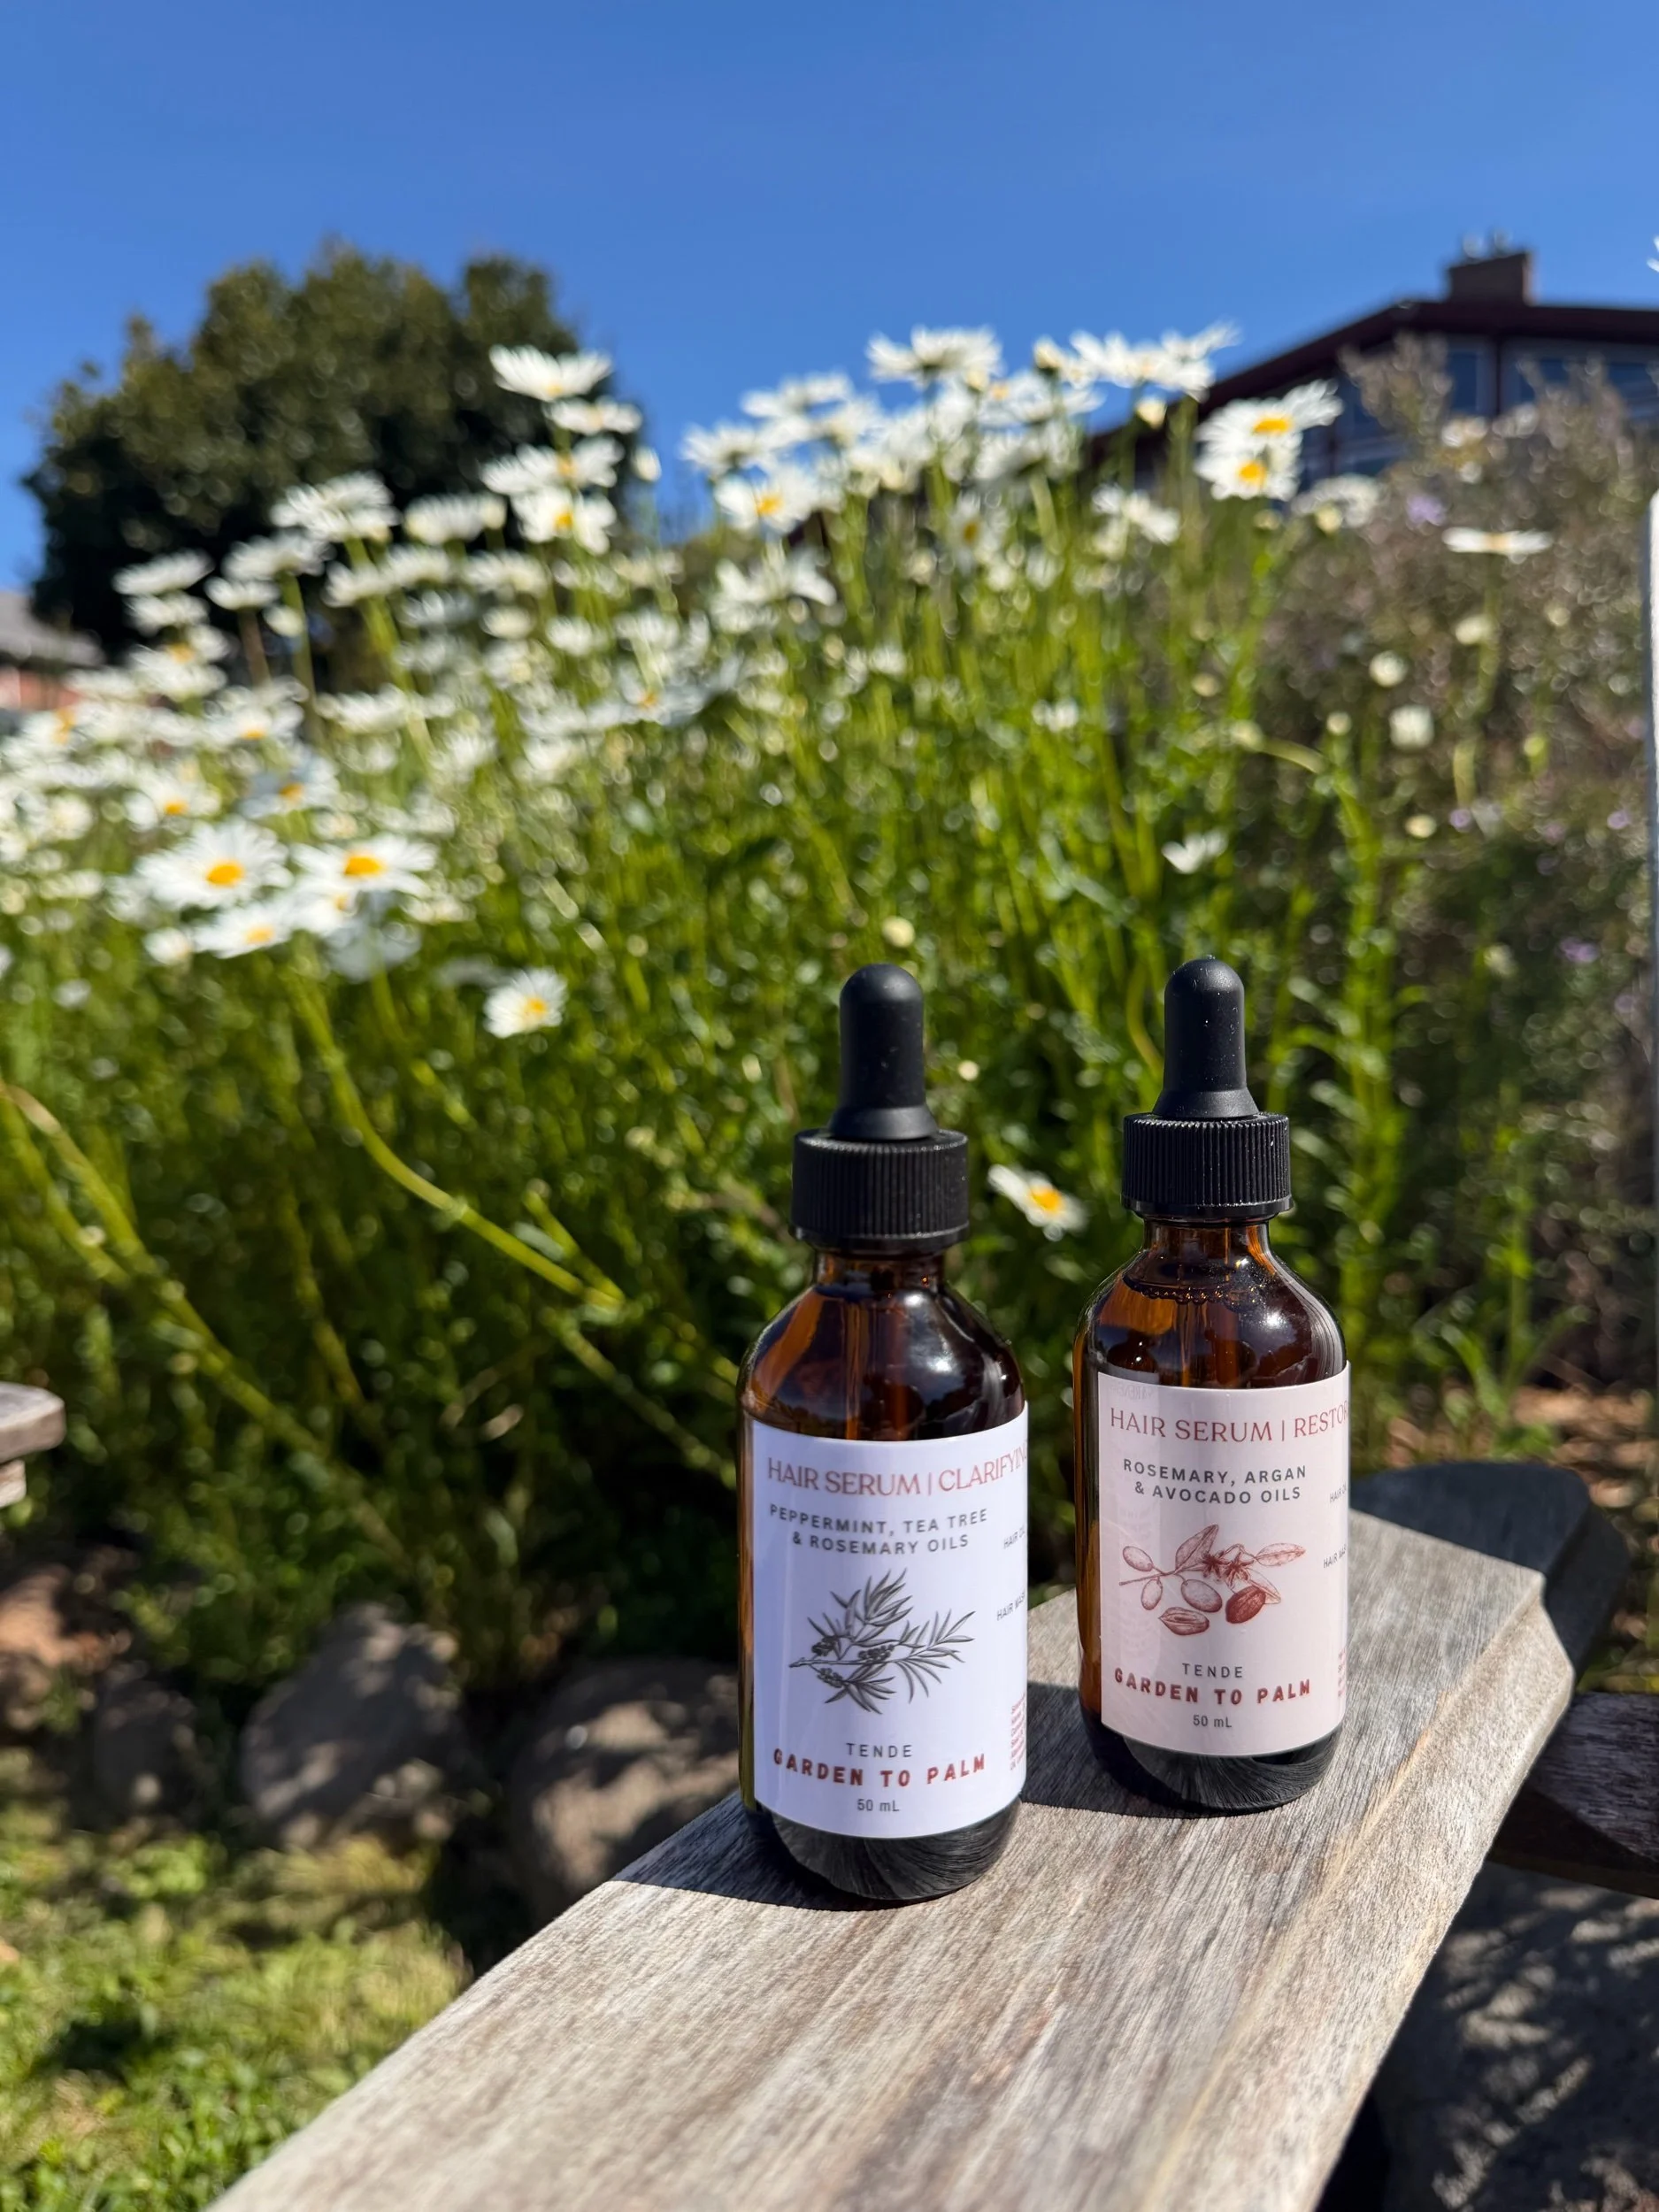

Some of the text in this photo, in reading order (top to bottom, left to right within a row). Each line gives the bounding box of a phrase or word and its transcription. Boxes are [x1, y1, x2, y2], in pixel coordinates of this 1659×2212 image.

[1110, 1407, 1166, 1438] HAIR
[1175, 1419, 1272, 1442] SERUM
[767, 1456, 819, 1491] HAIR
[825, 1471, 921, 1495] SERUM
[1123, 1458, 1307, 1487] ROSEMARY, ARGAN
[1134, 1481, 1301, 1504] & AVOCADO OILS
[770, 1503, 987, 1537] PEPPERMINT, TEA TREE
[792, 1531, 968, 1555] & ROSEMARY OILS
[1323, 1553, 1337, 1568] HAIR
[996, 1602, 1014, 1621] HAIR
[1182, 1663, 1243, 1678] TENDE
[1114, 1667, 1310, 1705] GARDEN TO PALM
[1193, 1715, 1232, 1728] 50 mL
[846, 1742, 913, 1758] TENDE
[773, 1747, 985, 1787] GARDEN TO PALM
[856, 1799, 900, 1812] 50 mL
